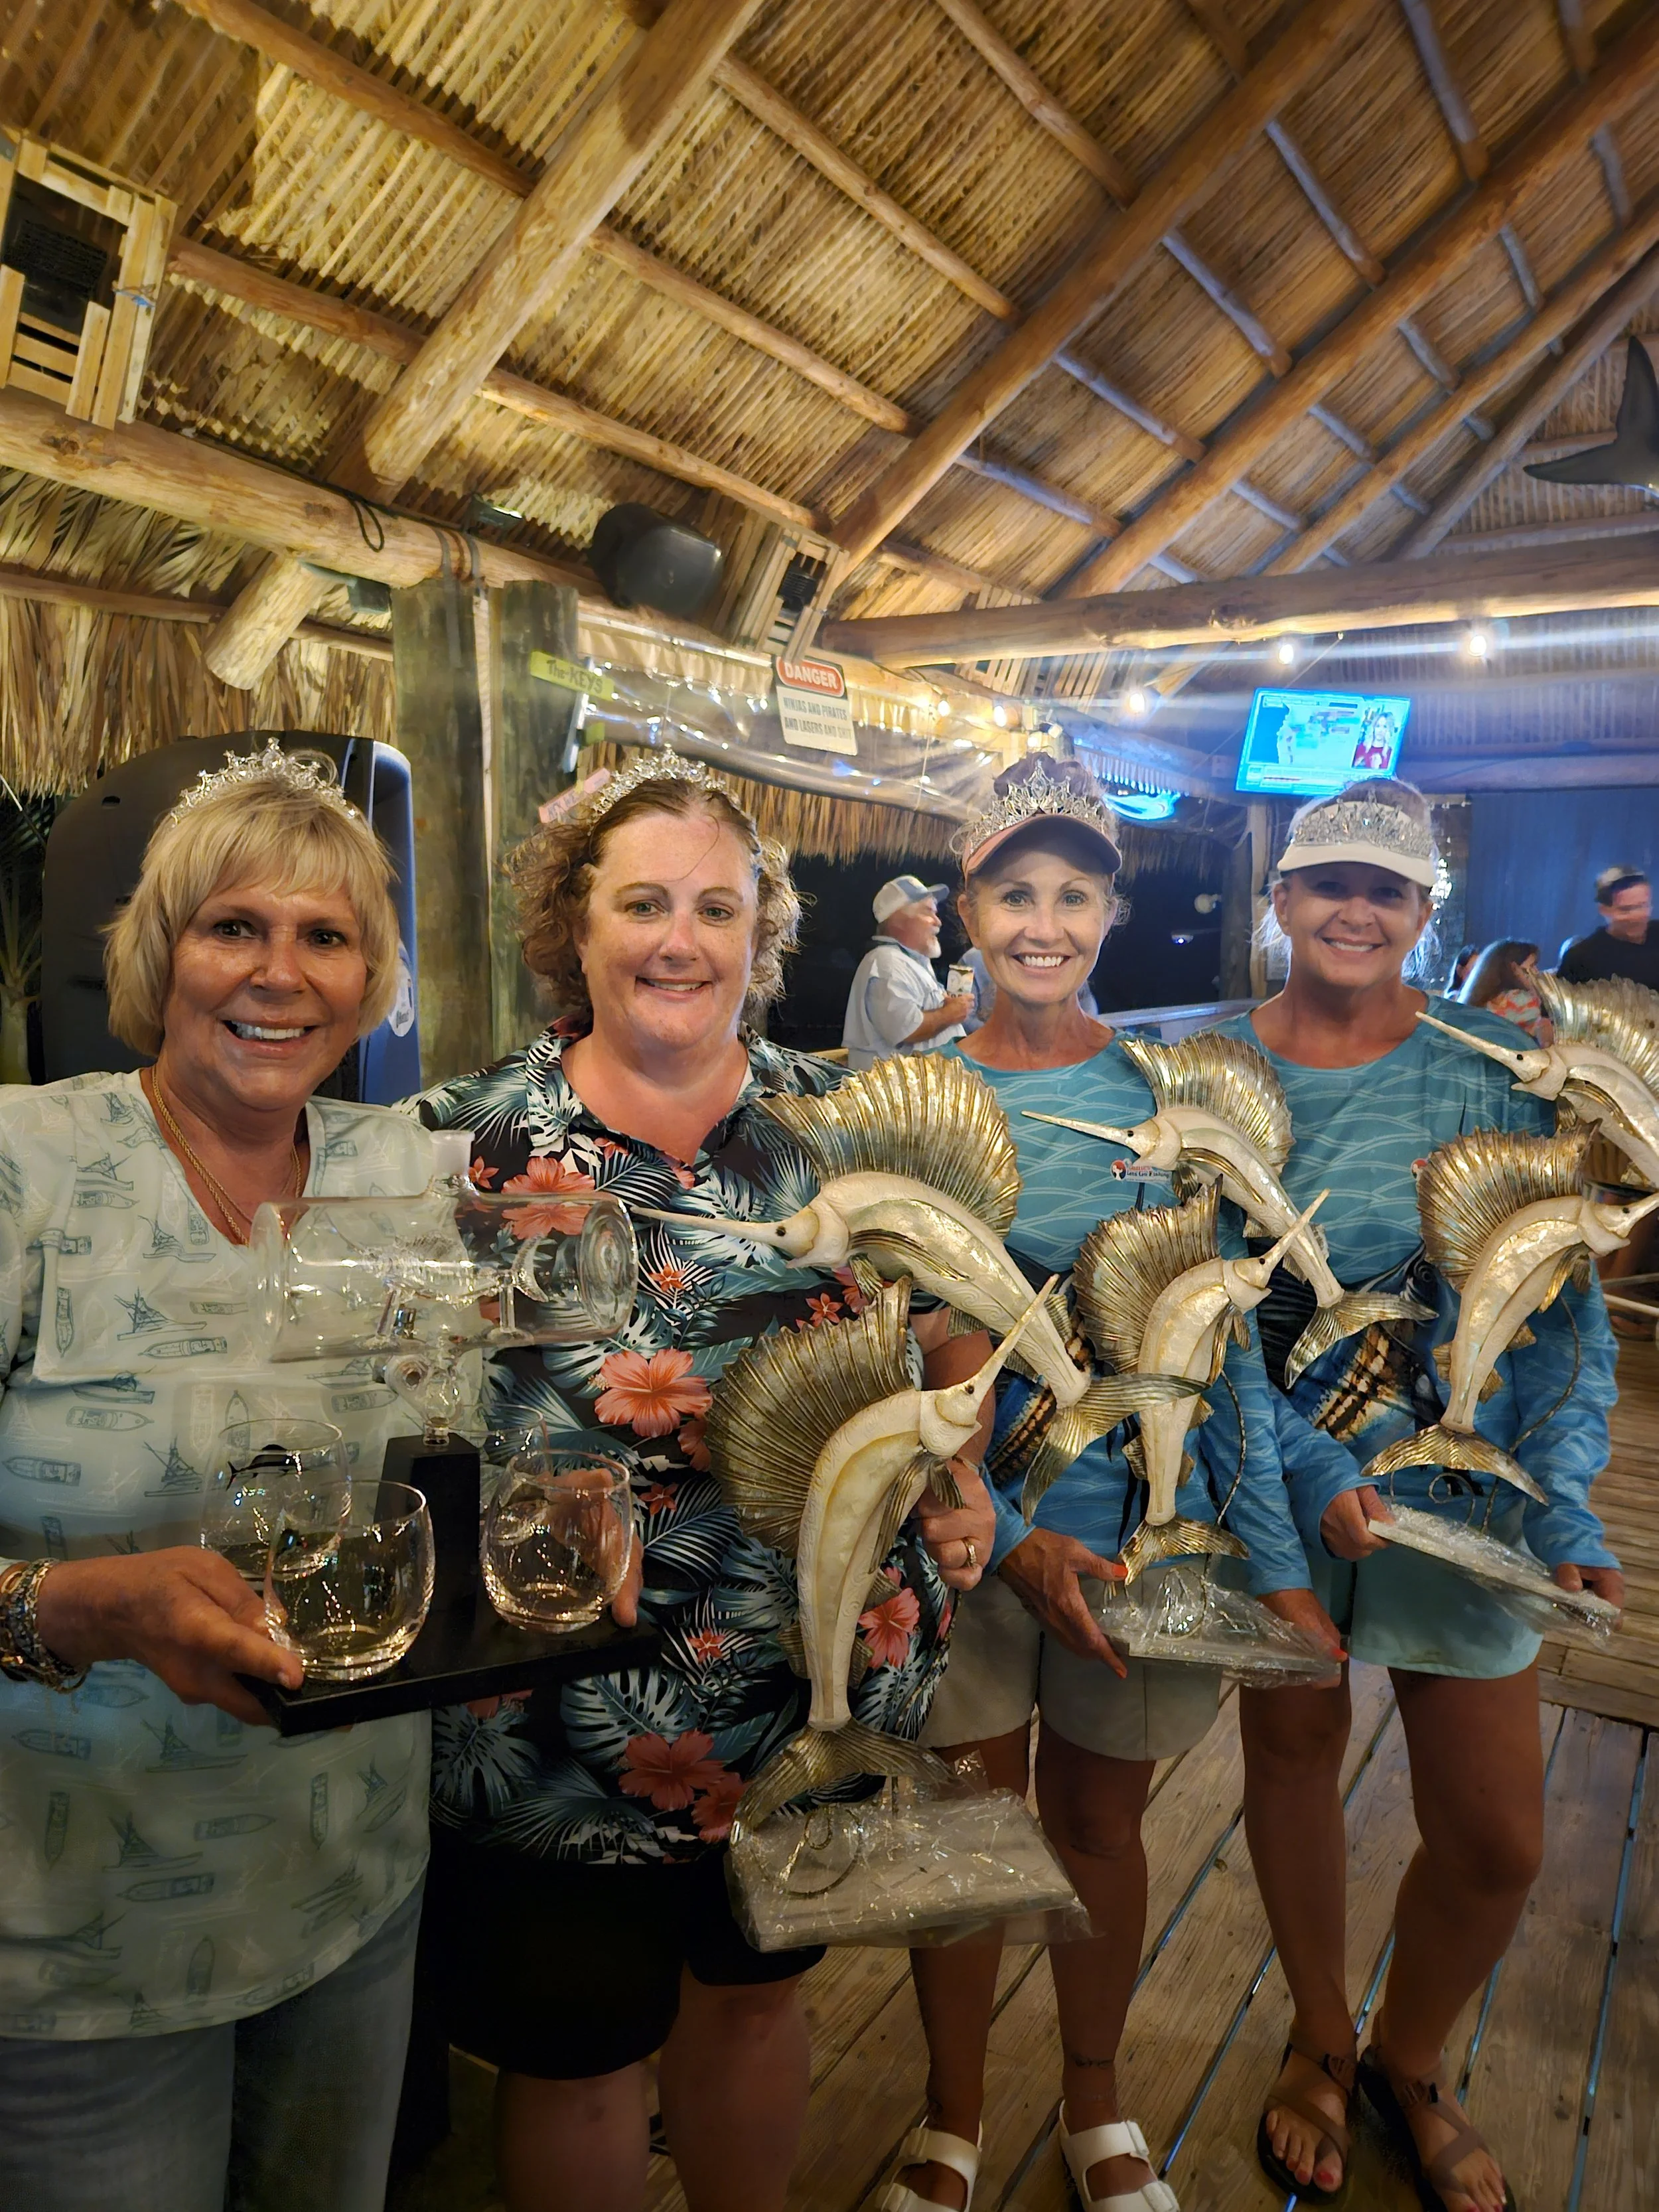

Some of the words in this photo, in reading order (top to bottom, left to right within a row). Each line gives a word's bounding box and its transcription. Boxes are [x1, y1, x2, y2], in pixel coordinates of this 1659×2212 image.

[784, 662, 838, 690] DANGER
[783, 697, 808, 713] NINJAS
[808, 701, 821, 715] AND
[822, 705, 847, 721] PIRATES
[784, 717, 799, 731] AND
[799, 719, 824, 734] LASERS
[824, 724, 837, 738] AND
